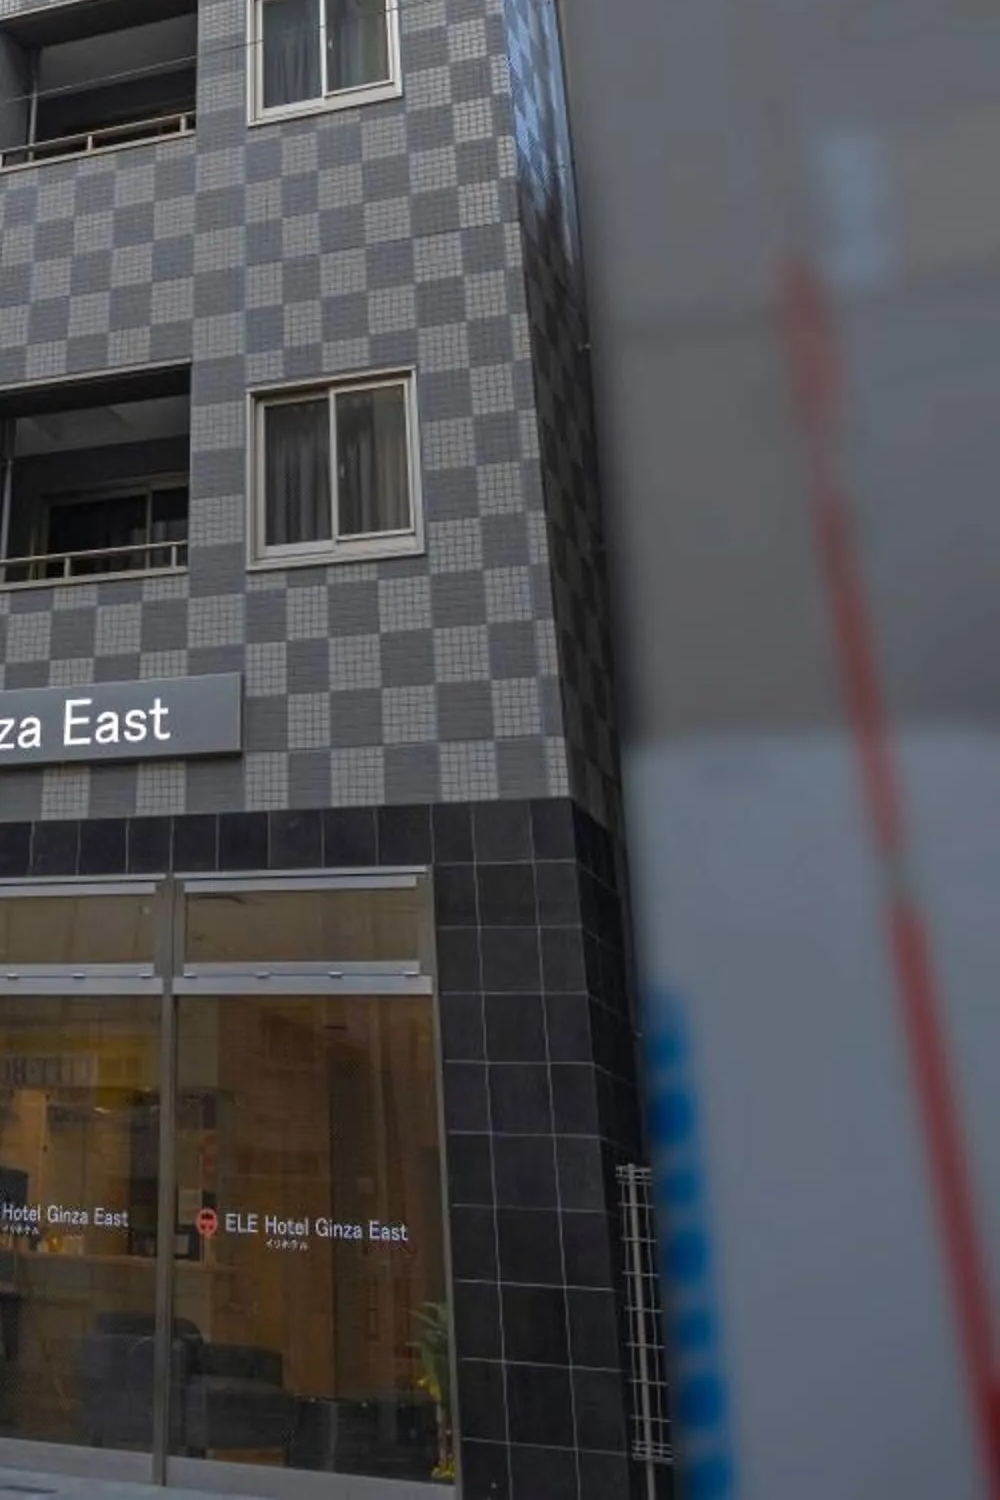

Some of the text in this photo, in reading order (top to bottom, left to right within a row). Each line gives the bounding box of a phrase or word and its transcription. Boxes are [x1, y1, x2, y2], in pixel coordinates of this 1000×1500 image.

[61, 697, 171, 747] East
[2, 1203, 41, 1220] Hotel
[47, 1204, 88, 1224] Ginza
[94, 1208, 128, 1226] East
[225, 1213, 408, 1241] ELE Hotel Ginza East
